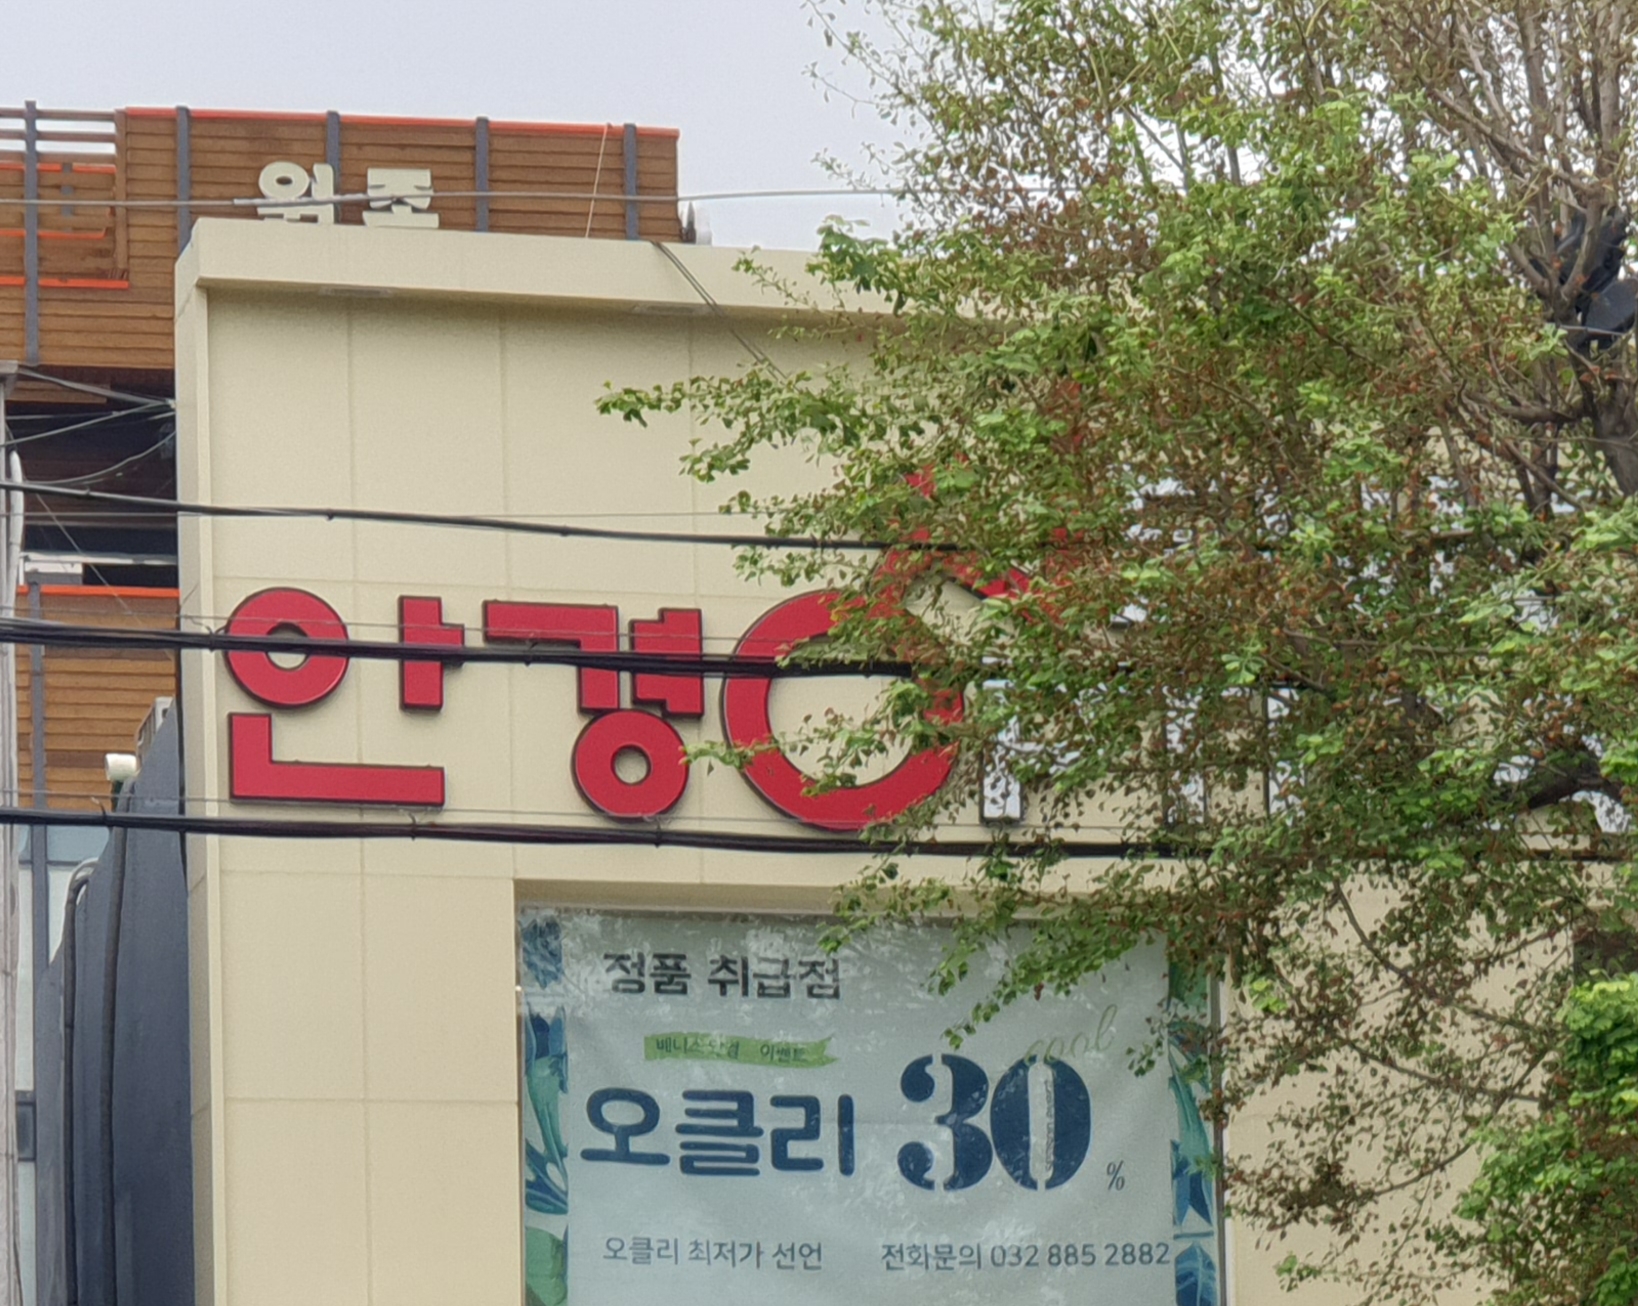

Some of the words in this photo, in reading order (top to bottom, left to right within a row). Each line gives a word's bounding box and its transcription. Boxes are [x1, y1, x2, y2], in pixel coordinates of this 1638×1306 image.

[603, 950, 691, 997] 정품
[707, 953, 842, 1001] 취급점
[580, 1086, 856, 1178] 오클리
[603, 1236, 680, 1267] 오클리
[687, 1236, 766, 1270] 최저가
[772, 1240, 824, 1272] 선언
[880, 1241, 983, 1272] 전화문의
[989, 1242, 1040, 1269] 032
[1046, 1242, 1098, 1268] 885
[1103, 1241, 1172, 1268] 2882
